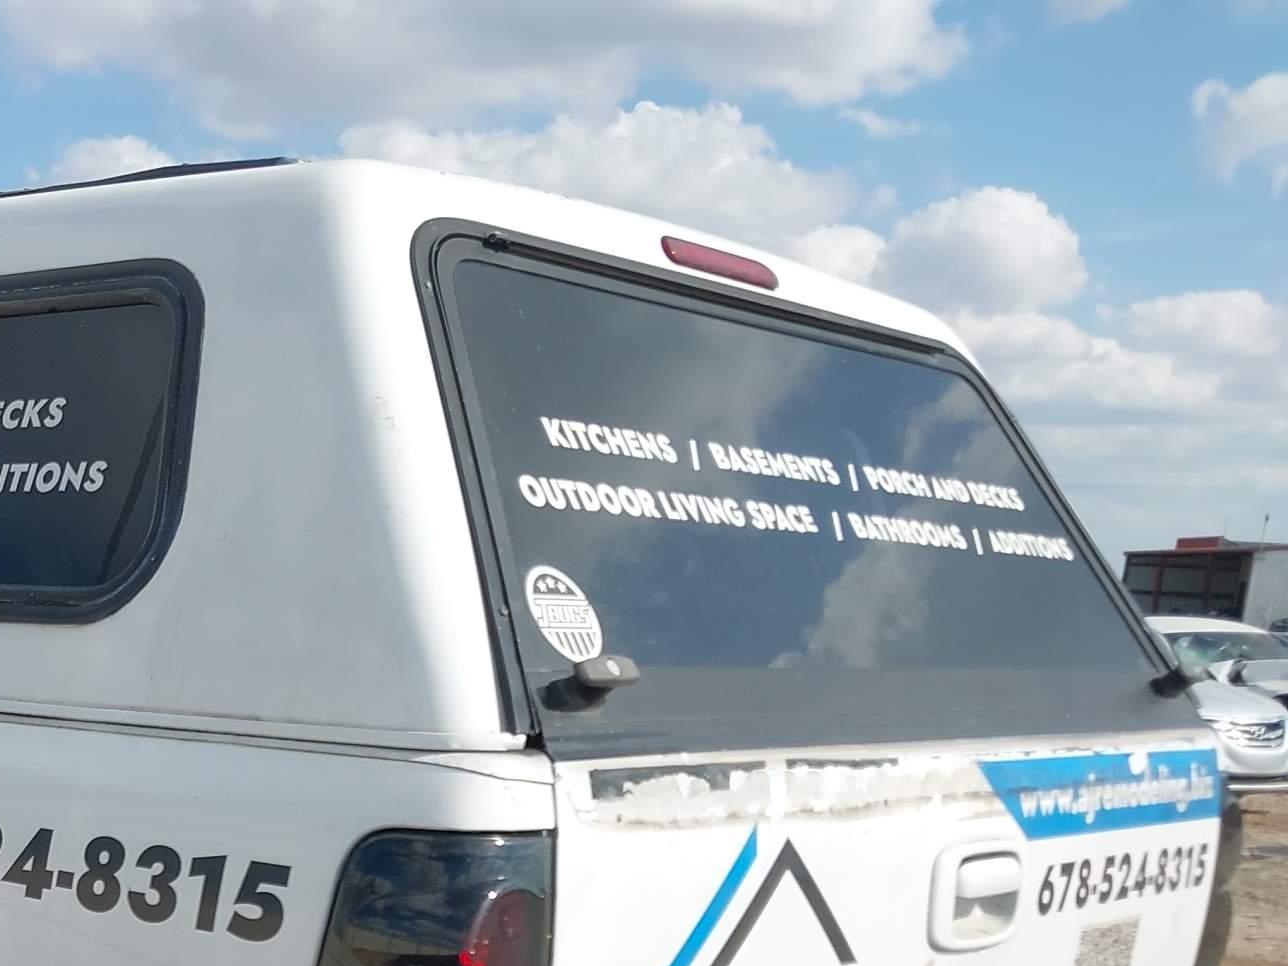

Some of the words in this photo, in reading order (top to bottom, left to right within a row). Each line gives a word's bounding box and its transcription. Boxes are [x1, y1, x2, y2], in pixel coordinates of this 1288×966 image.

[540, 416, 678, 463] KITCHENS
[708, 441, 841, 486] BASEMENTS
[863, 465, 927, 499] PORCH
[931, 474, 969, 505] AND
[968, 479, 1025, 512] DECKS
[518, 474, 661, 519] OUTDOOR
[664, 492, 746, 528] LIVING
[751, 500, 819, 534] SPACE
[849, 513, 968, 551] BATHROOMS
[988, 530, 1074, 561] ADDITIONS
[1038, 842, 1209, 917] 678-524-8315
